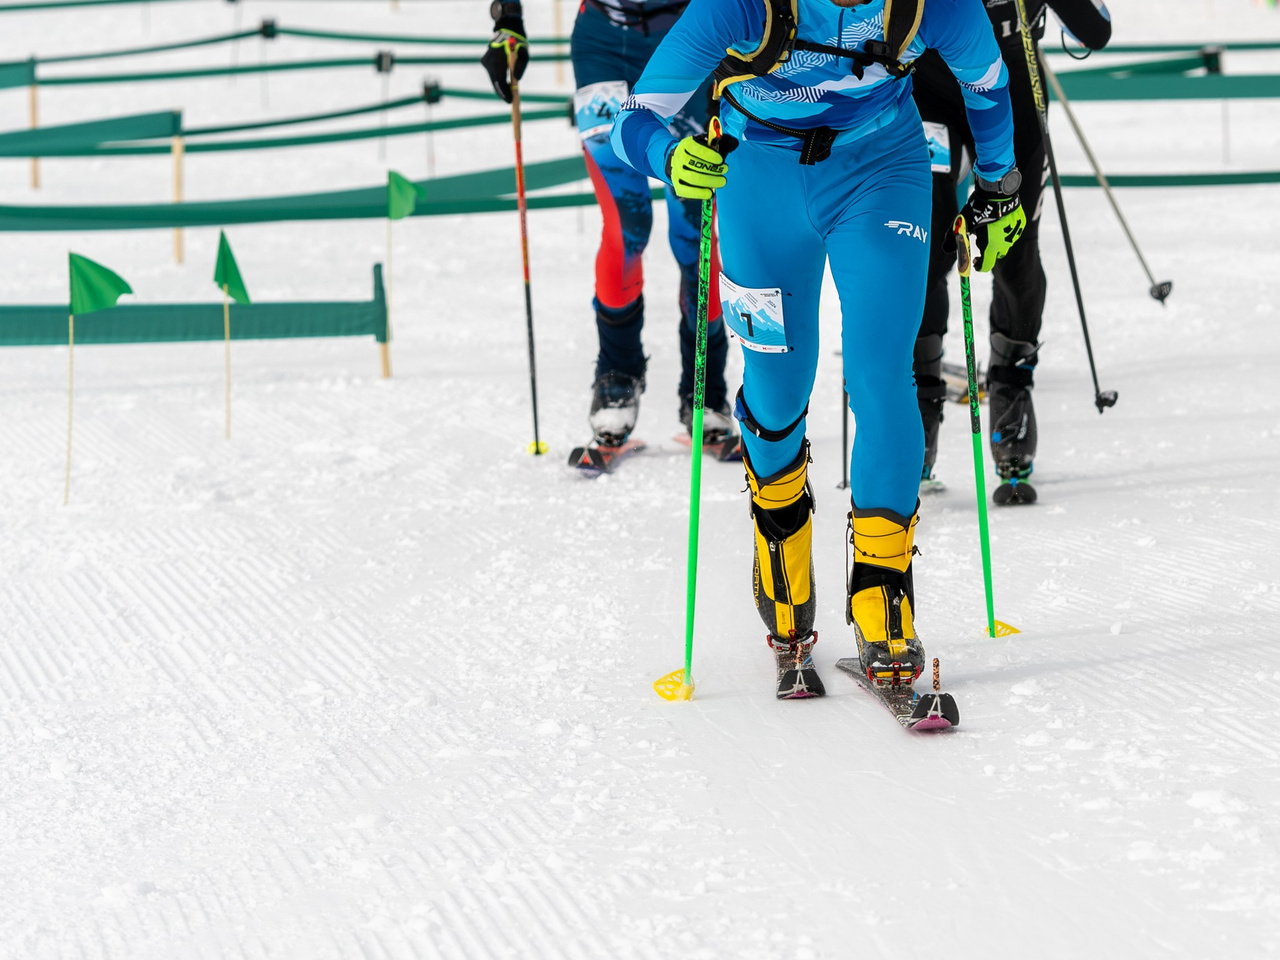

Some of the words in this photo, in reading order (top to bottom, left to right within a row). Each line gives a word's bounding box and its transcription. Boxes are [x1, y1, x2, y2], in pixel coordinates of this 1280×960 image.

[597, 101, 612, 120] 4
[884, 219, 928, 244] RAY
[740, 312, 754, 338] 1
